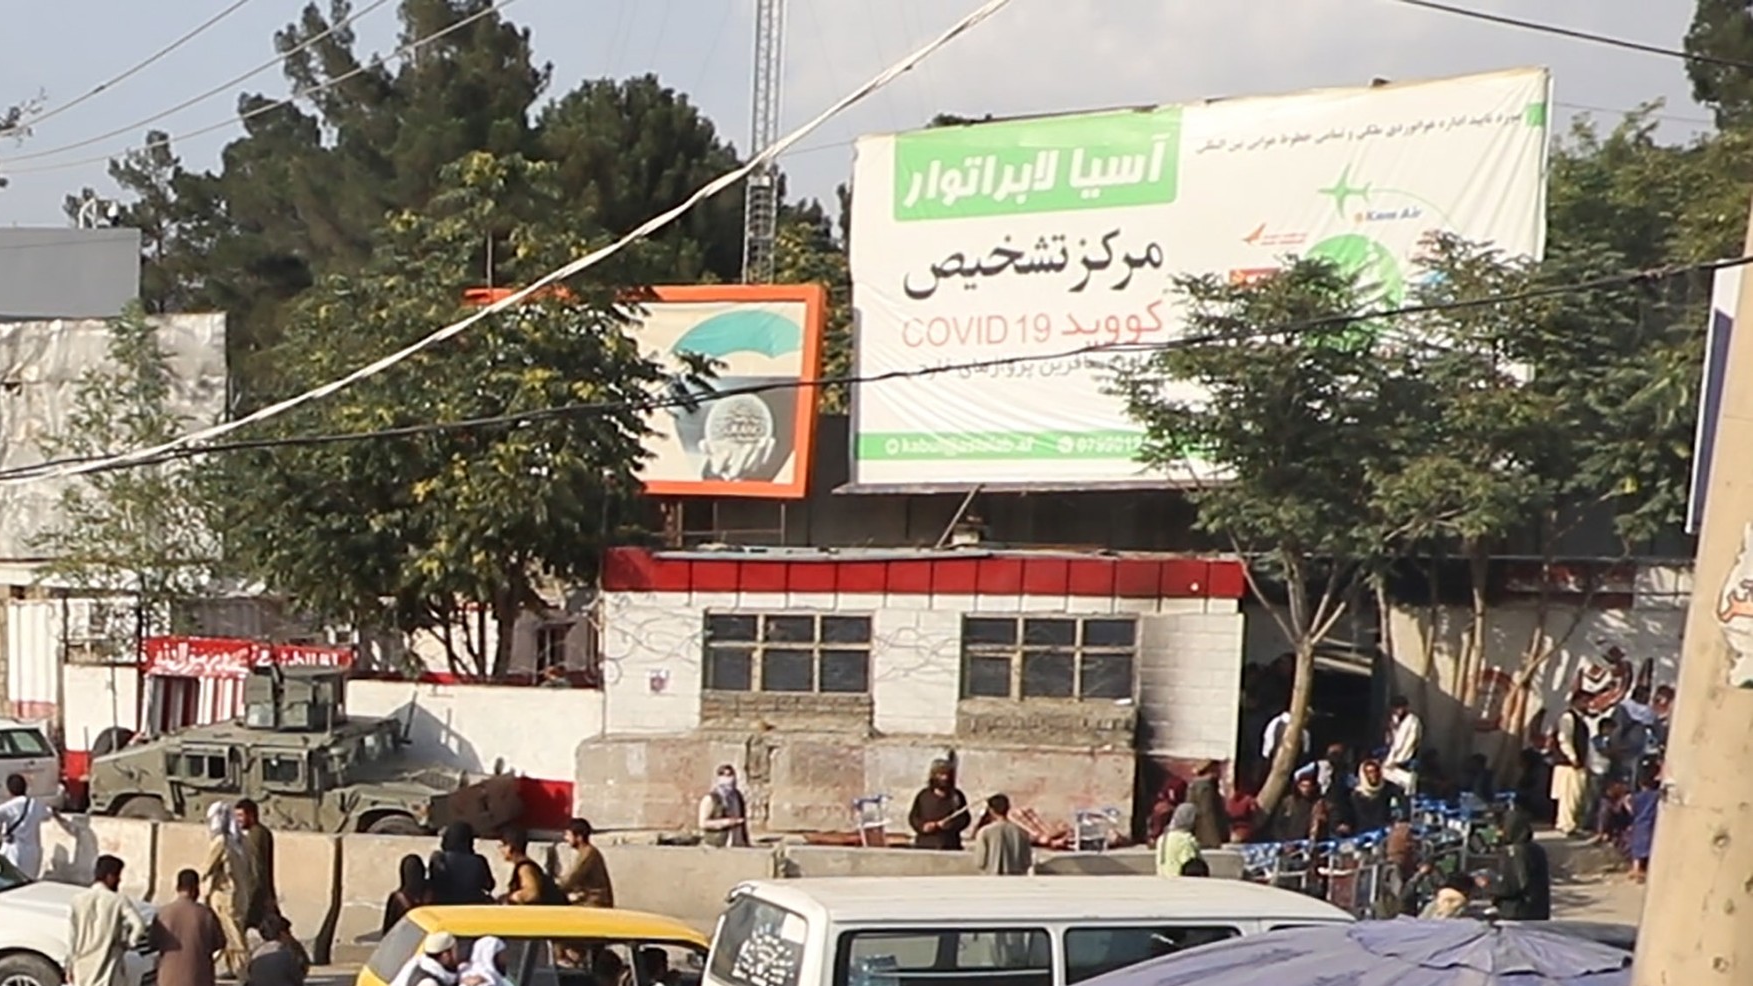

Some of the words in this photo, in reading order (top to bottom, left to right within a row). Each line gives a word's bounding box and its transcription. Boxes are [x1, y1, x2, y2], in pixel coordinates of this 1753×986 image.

[903, 149, 1060, 208] لابراتوار
[1069, 133, 1171, 199] آسیا
[903, 234, 1068, 301] تشخیص
[1068, 228, 1164, 293] مرکز
[902, 315, 1008, 348] COVID
[1017, 312, 1051, 344] 19
[1061, 300, 1163, 348] کووید
